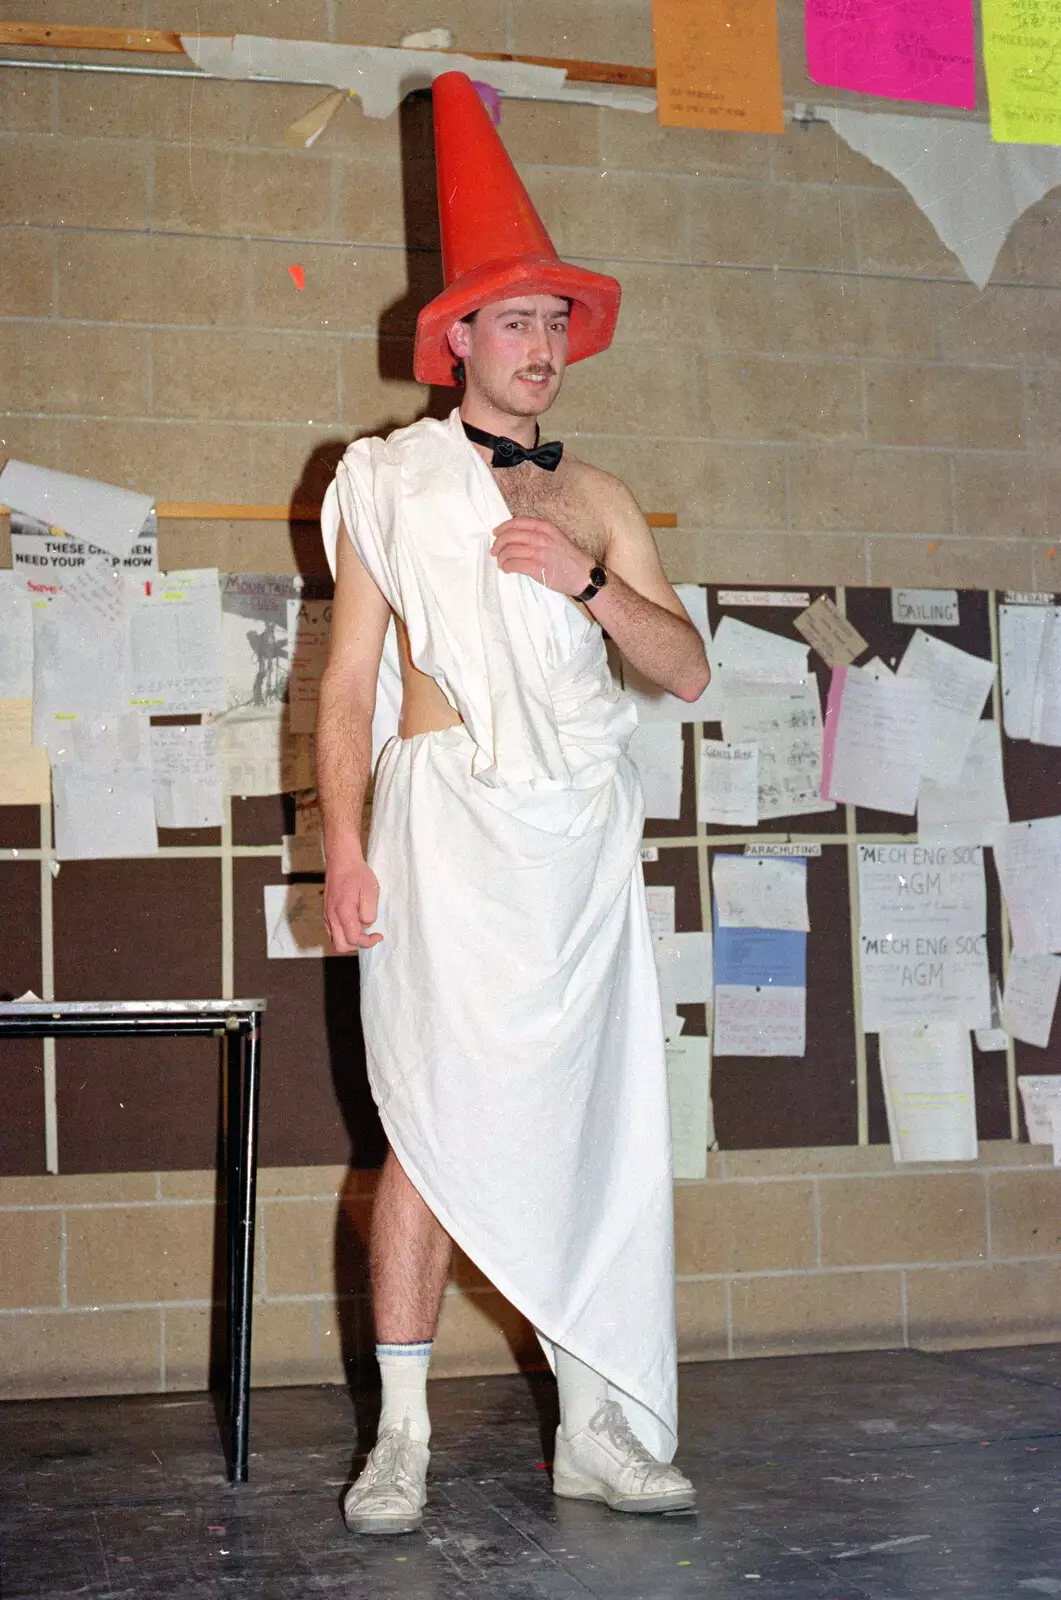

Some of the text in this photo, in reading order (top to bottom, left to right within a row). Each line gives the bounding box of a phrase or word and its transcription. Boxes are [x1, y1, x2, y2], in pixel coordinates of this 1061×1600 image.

[44, 542, 85, 555] THESE
[15, 553, 48, 566] NEED
[51, 556, 85, 567] YOUR
[123, 558, 152, 567] NOW
[898, 593, 954, 620] SAILING
[745, 844, 820, 855] PARACHUTING
[863, 846, 982, 865] MECH ENG SOC
[898, 872, 942, 897] AGM
[865, 936, 984, 956] MECH ENG SOC
[902, 961, 944, 988] AGM
